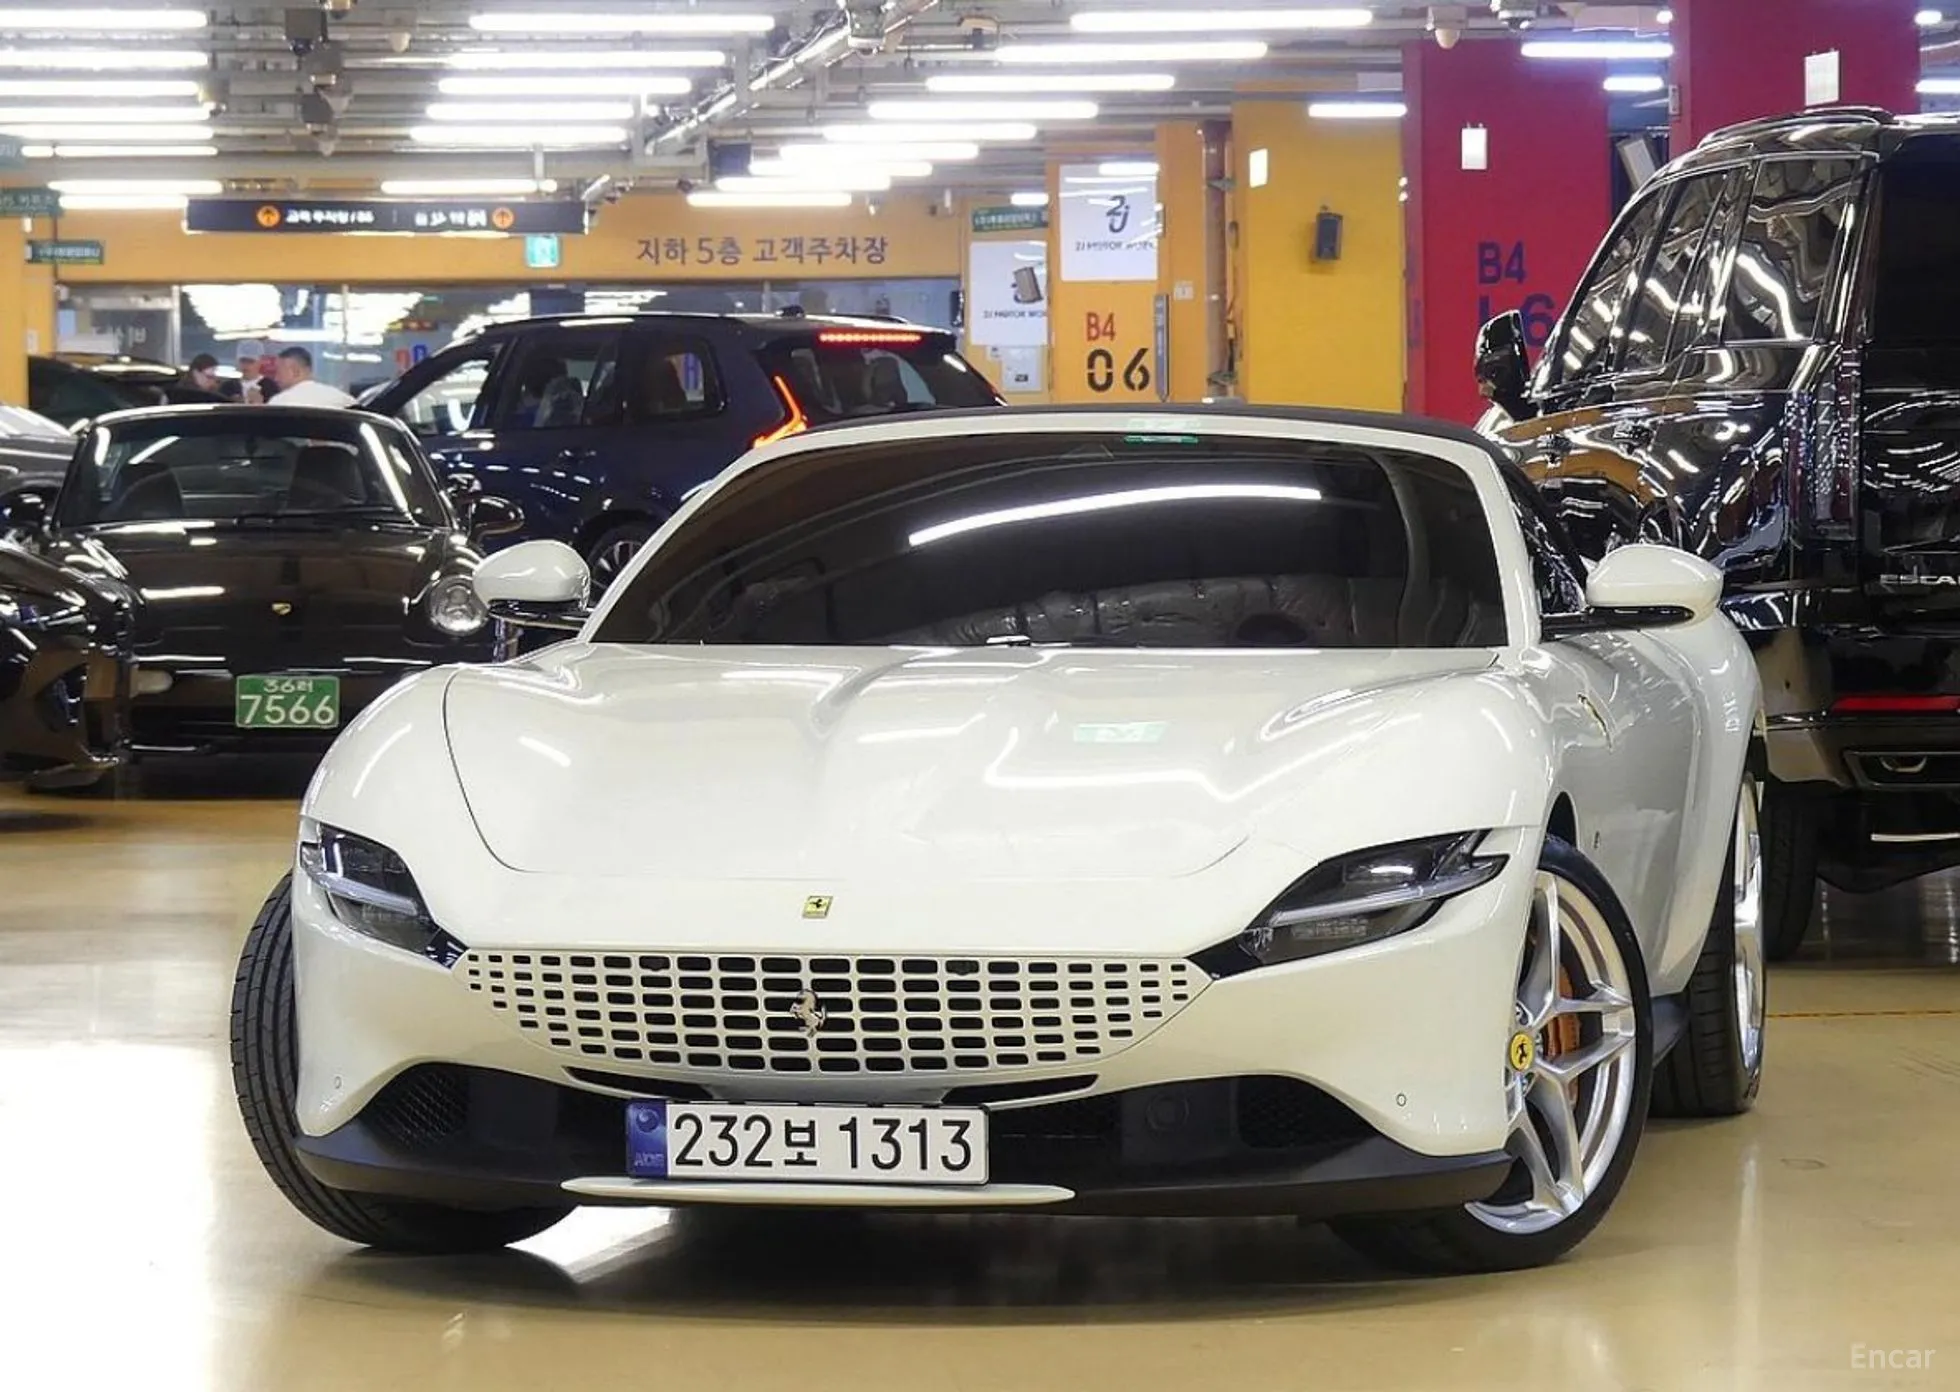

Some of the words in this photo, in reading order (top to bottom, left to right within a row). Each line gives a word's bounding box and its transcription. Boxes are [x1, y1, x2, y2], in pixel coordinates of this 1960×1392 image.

[637, 237, 690, 265] 지하
[696, 236, 743, 266] 5층
[752, 236, 889, 265] 고객주차장
[1478, 241, 1526, 284] B4
[1086, 312, 1116, 341] B4
[1087, 348, 1150, 392] 06
[240, 694, 334, 725] 7566
[674, 1112, 818, 1167] 232보
[839, 1116, 972, 1171] 1313
